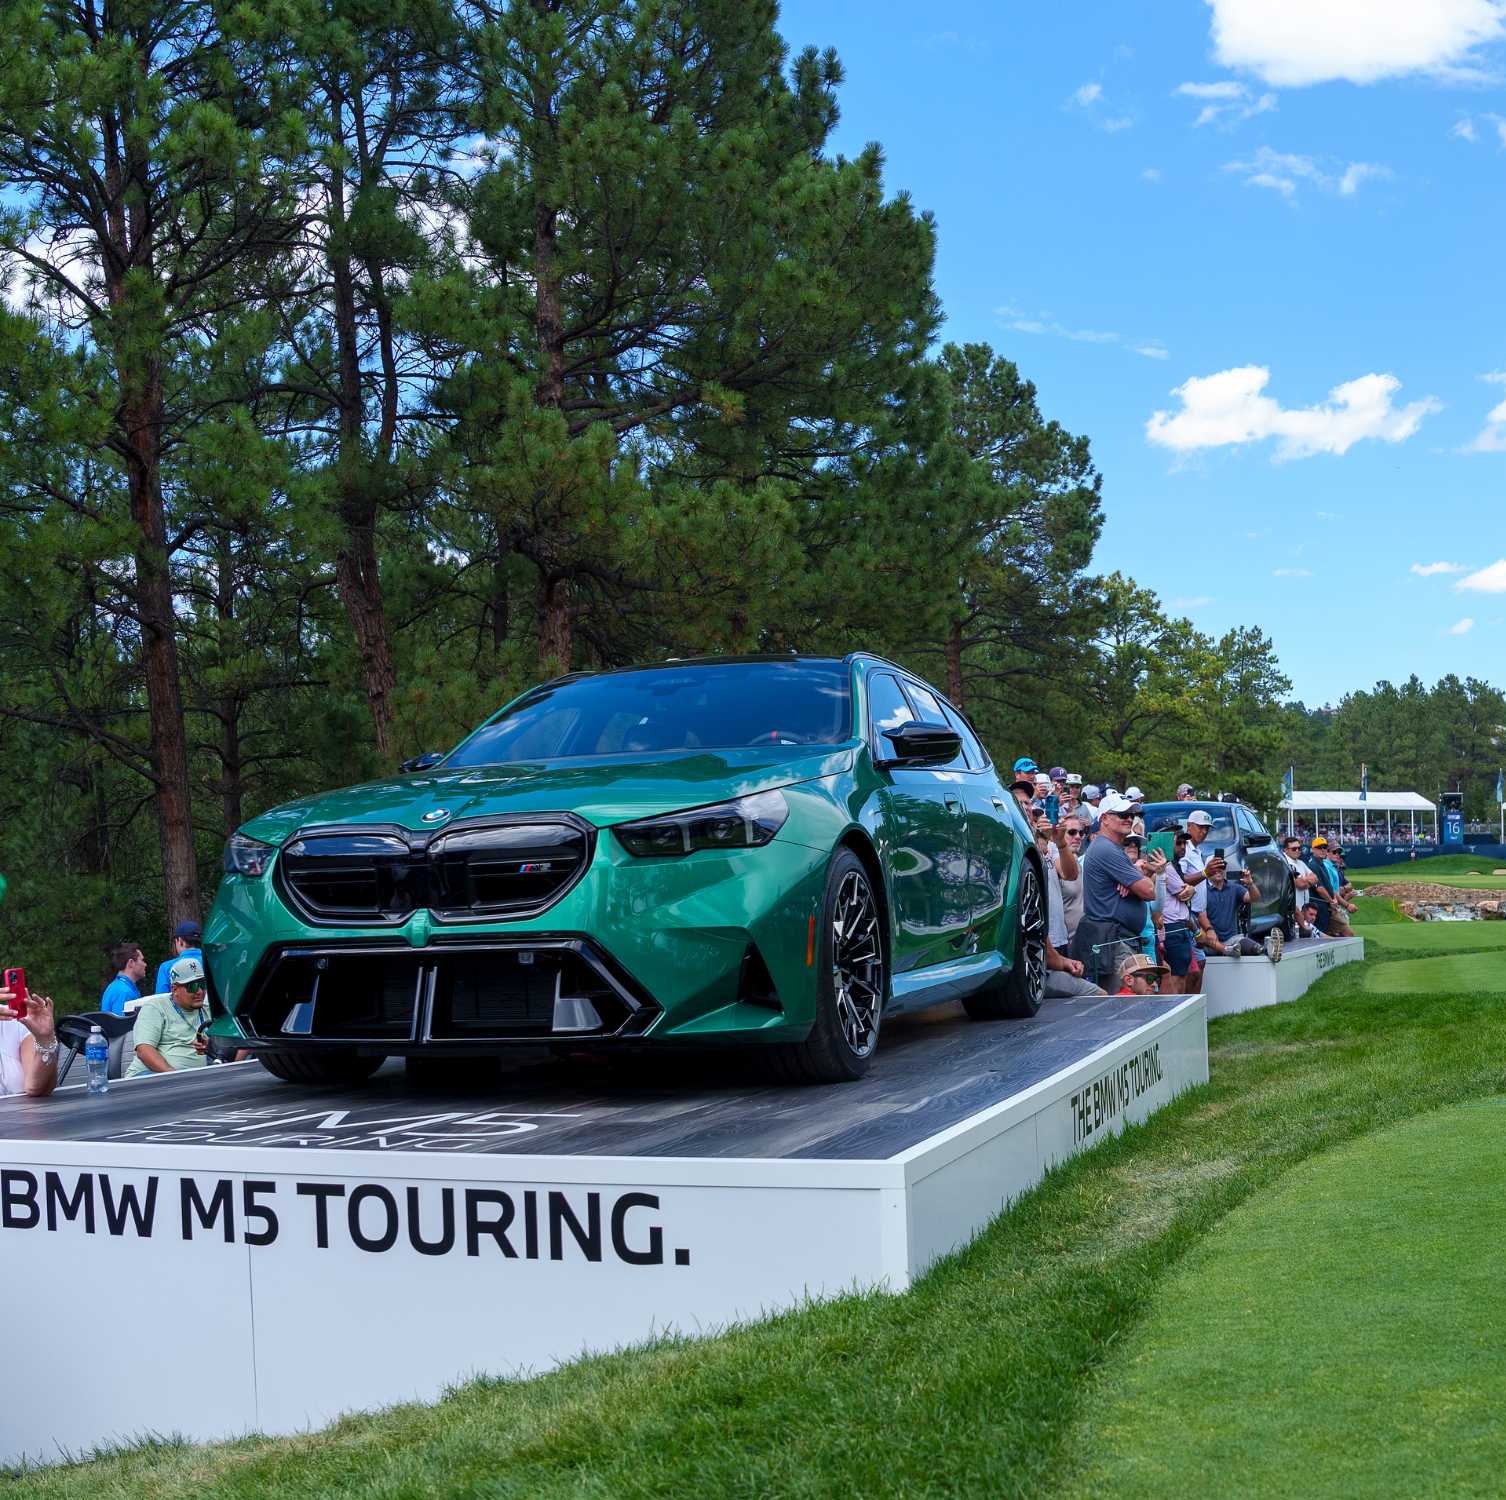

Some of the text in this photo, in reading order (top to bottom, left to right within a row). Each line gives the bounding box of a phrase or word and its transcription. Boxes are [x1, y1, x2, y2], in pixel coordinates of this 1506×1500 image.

[1446, 821, 1460, 834] 16
[1071, 1085, 1093, 1145] THE
[1093, 1072, 1116, 1130] BMW
[1116, 1064, 1130, 1109] M5
[230, 1110, 583, 1138] M5
[105, 1129, 488, 1150] TOURING
[1, 1168, 690, 1266] BMW M5 TOURING.
